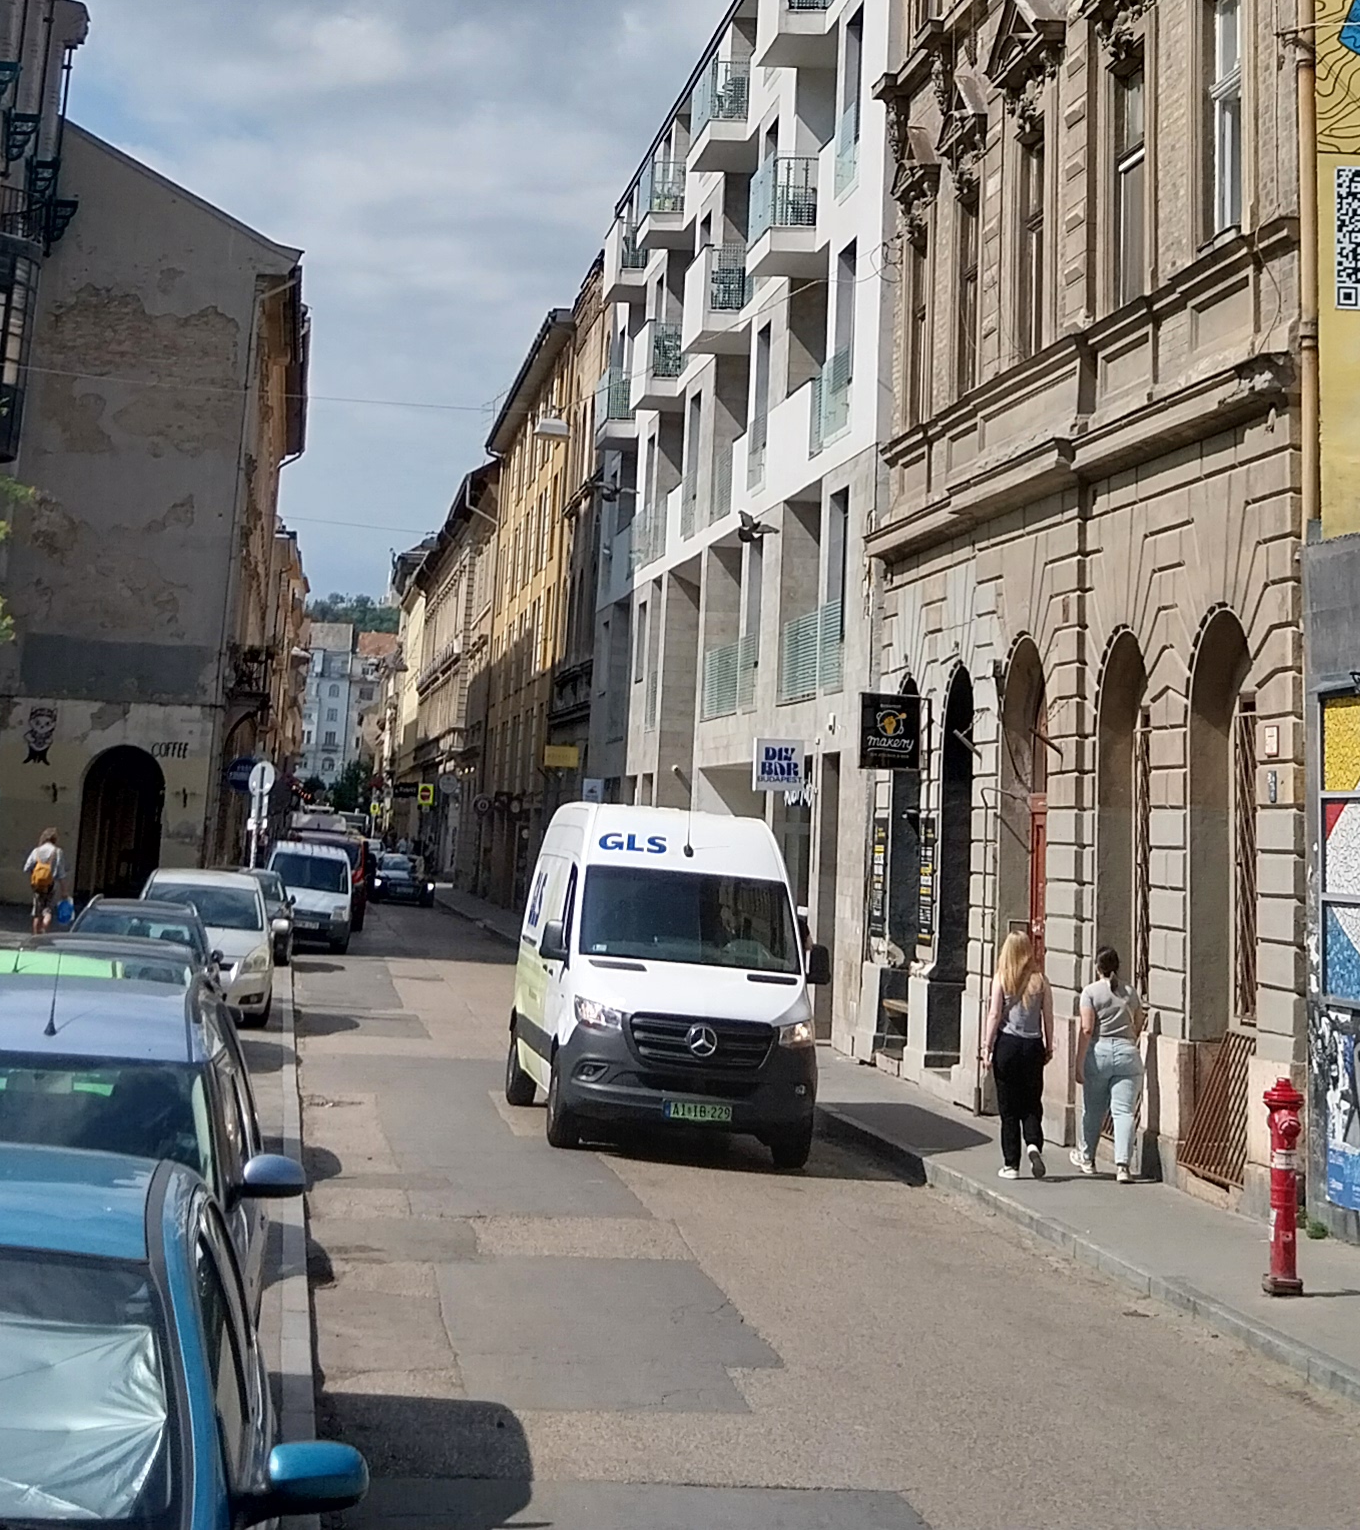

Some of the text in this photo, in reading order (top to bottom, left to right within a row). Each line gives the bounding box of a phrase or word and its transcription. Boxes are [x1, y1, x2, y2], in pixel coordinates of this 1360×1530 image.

[151, 742, 189, 759] COFFEE
[867, 735, 914, 753] makery
[757, 775, 802, 784] BUDAPEST
[598, 833, 667, 854] GLS
